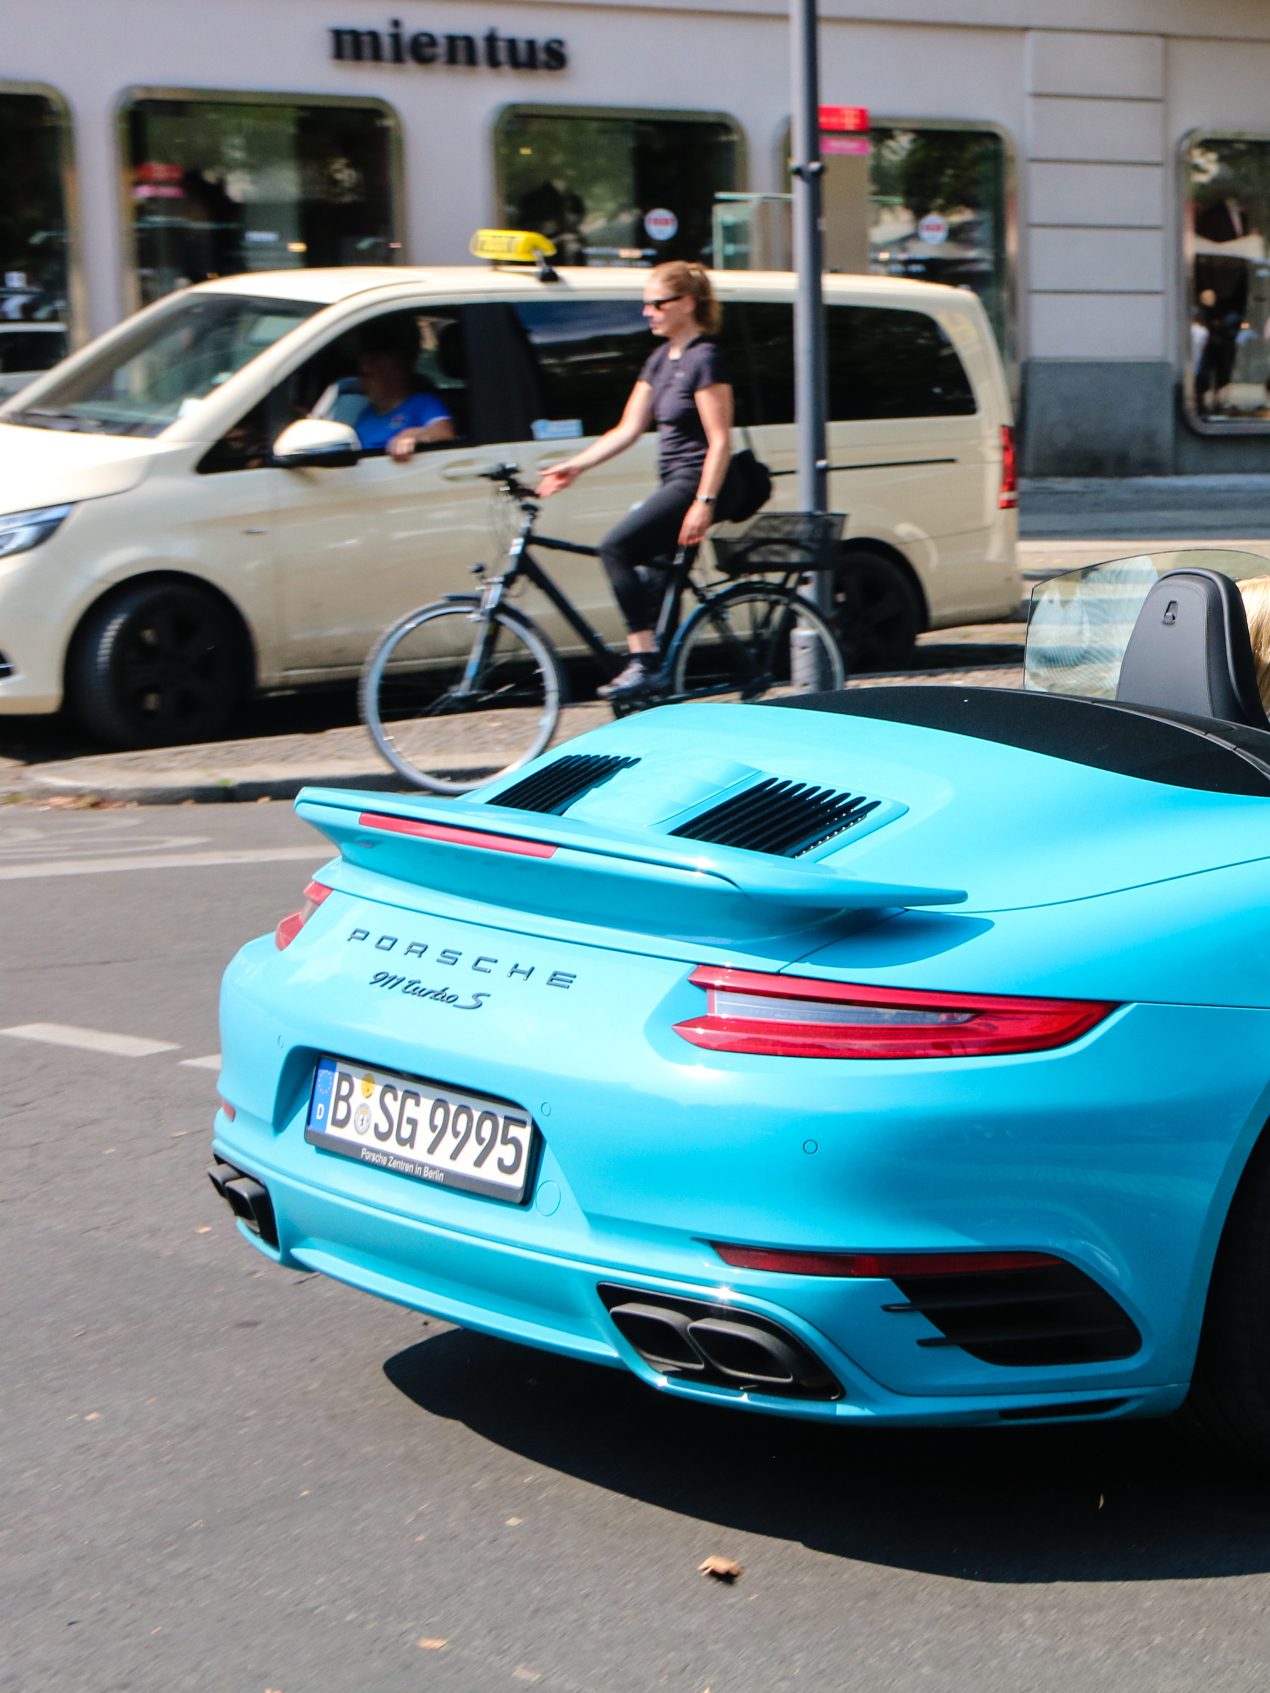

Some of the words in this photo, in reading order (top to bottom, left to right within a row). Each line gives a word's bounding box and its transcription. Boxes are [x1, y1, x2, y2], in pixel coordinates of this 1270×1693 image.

[329, 18, 567, 71] mientus
[347, 928, 577, 989] PORSCHE
[369, 971, 406, 990] 911
[401, 979, 459, 1004] turbo
[452, 992, 491, 1010] S
[331, 1071, 354, 1129] B
[426, 1098, 527, 1175] 9995
[360, 1147, 387, 1166] Porsche
[388, 1155, 414, 1173] Zentren
[414, 1162, 422, 1176] in
[423, 1165, 445, 1182] Berlin
